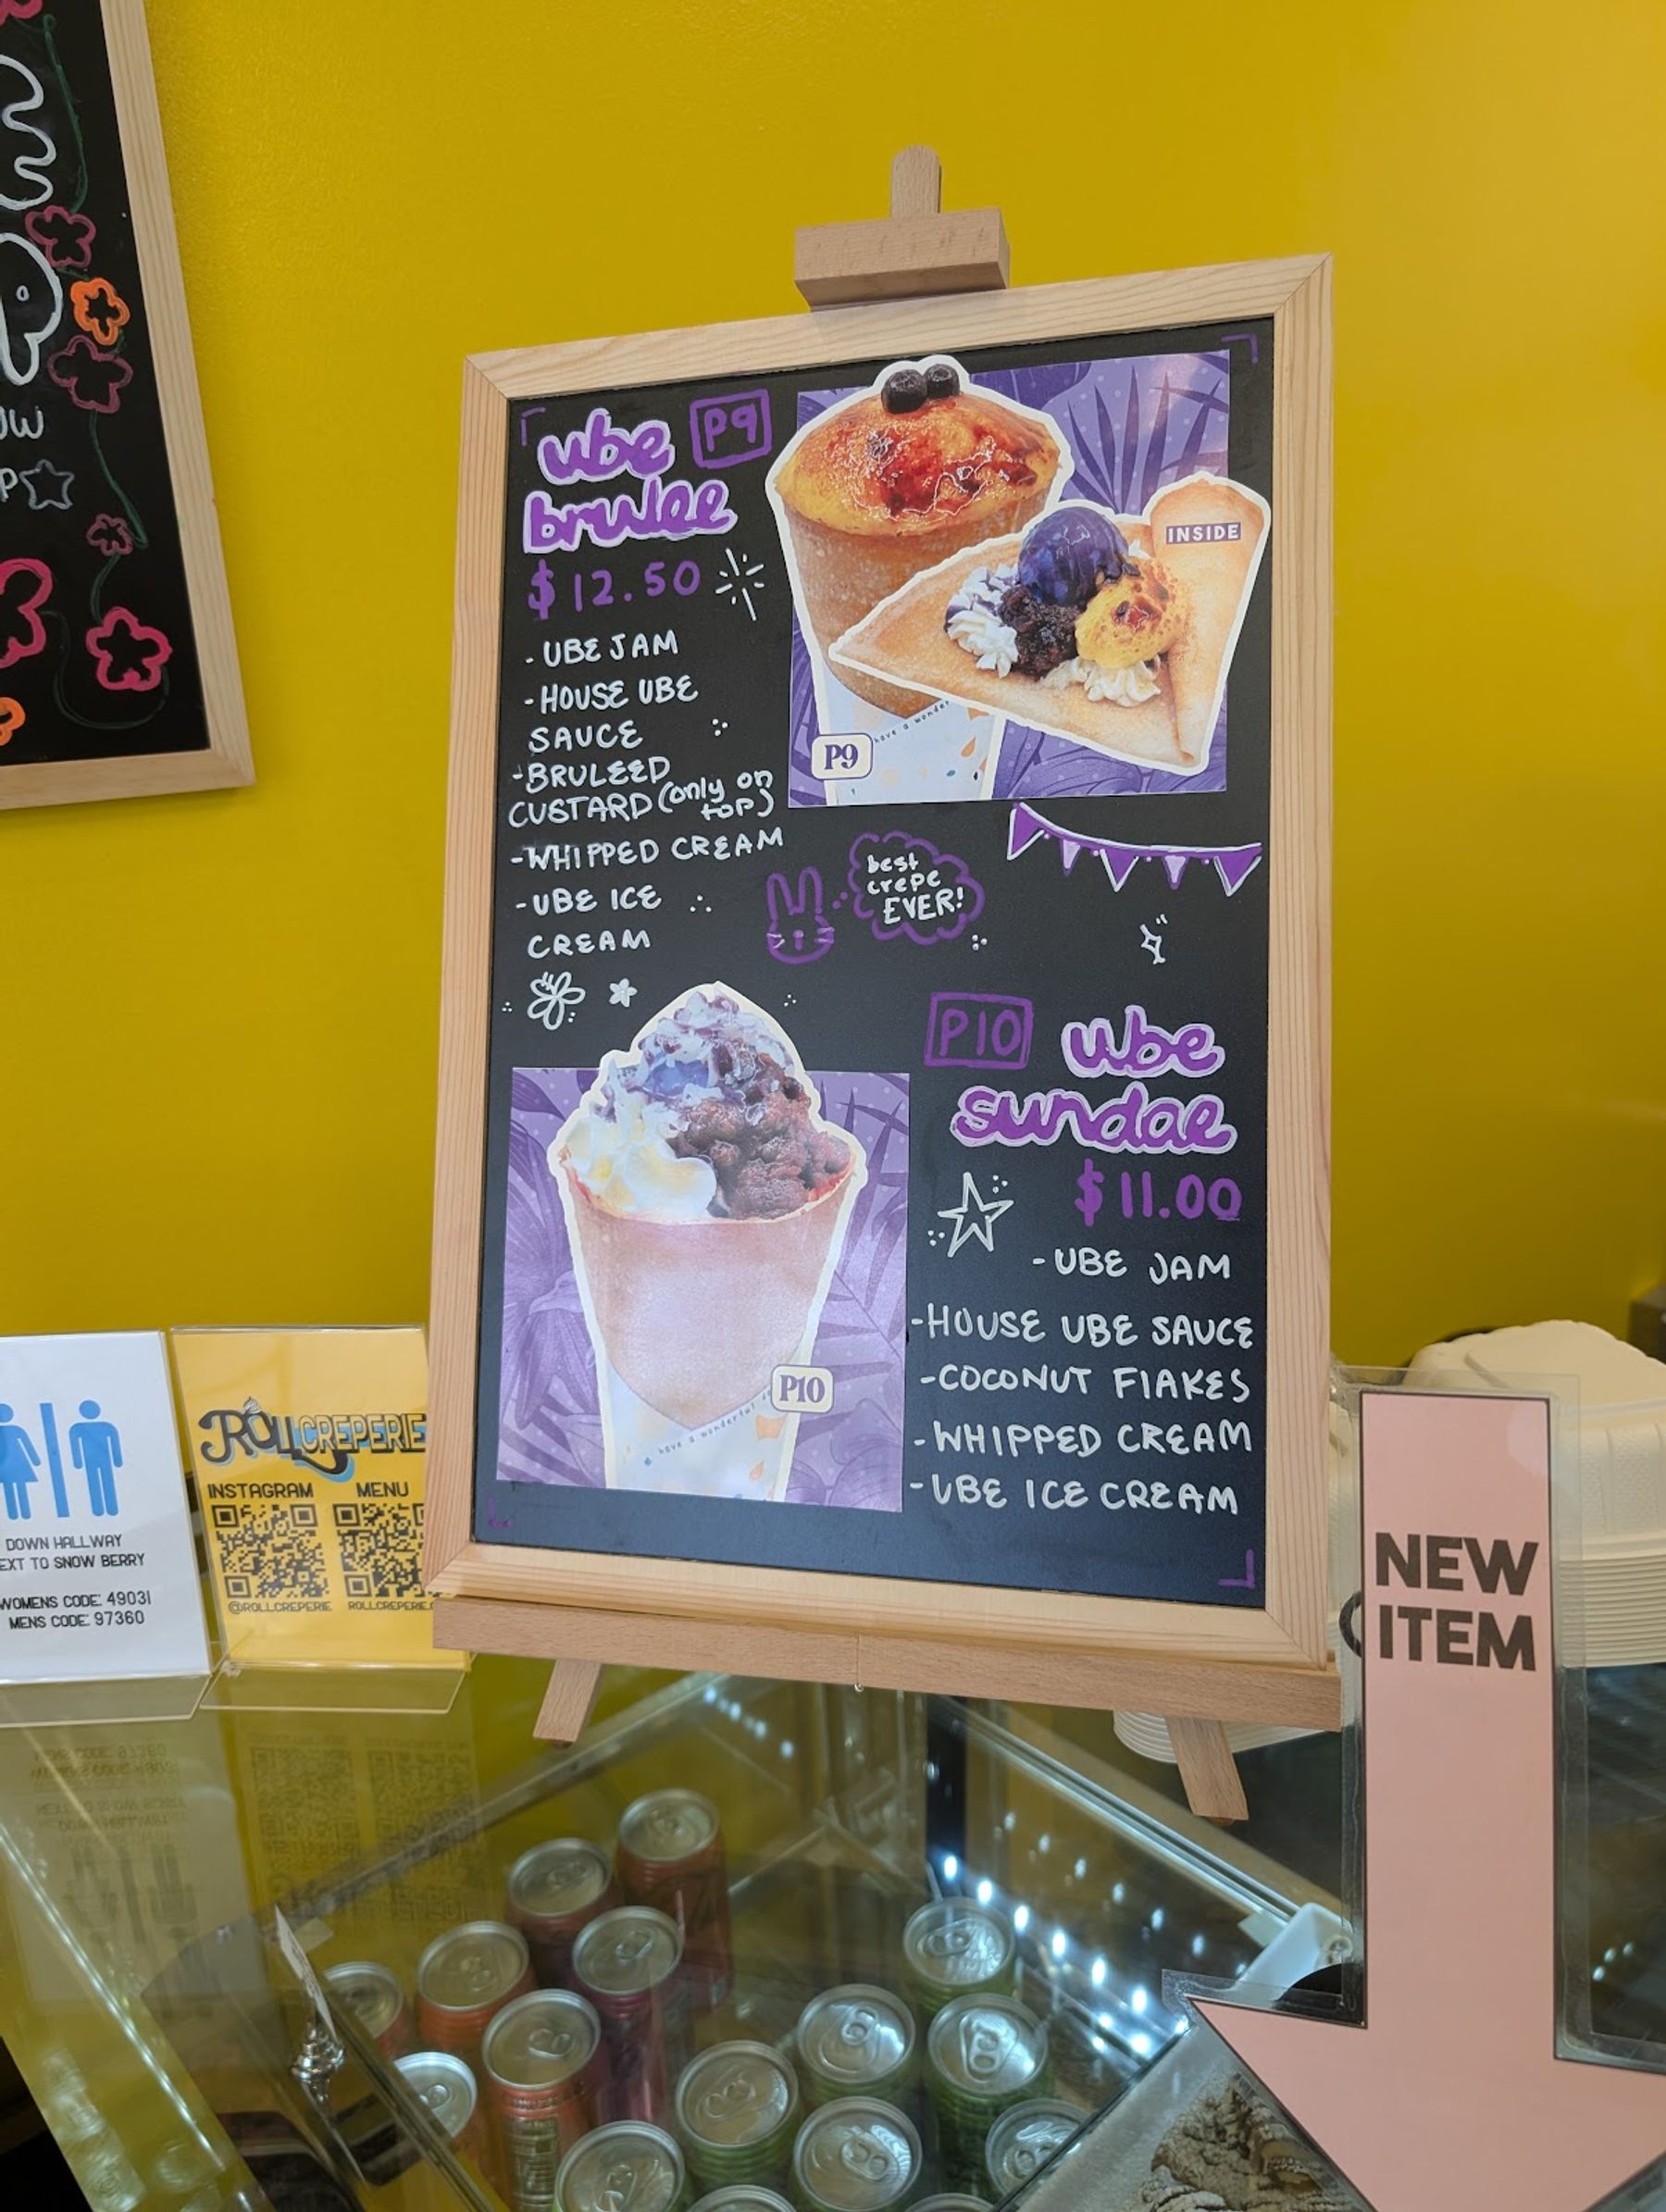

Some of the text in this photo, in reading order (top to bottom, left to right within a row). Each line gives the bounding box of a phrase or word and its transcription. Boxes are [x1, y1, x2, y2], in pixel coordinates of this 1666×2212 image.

[537, 407, 675, 485] ube
[523, 475, 739, 553] brulee
[1168, 524, 1239, 543] INSIDE
[609, 629, 678, 661] JAM
[639, 675, 699, 704] UBE
[528, 719, 643, 753] SAUCE
[824, 743, 859, 770] P9
[509, 792, 653, 827] CUSTARD
[737, 770, 774, 789] on
[671, 826, 784, 861] CREAM
[866, 851, 918, 874] best
[611, 885, 663, 911] ICE
[866, 870, 941, 895] crepe
[883, 887, 964, 925] EVER!
[528, 928, 651, 959] CREAM
[939, 1008, 1021, 1057] P10
[1061, 1004, 1225, 1078] ube
[950, 1081, 1238, 1155] sundae
[1149, 1252, 1231, 1285] JAM
[1061, 1313, 1138, 1348] UBE
[1151, 1315, 1253, 1348] SAUCE
[778, 1374, 826, 1403] P10
[1117, 1419, 1252, 1456] CREAM
[208, 1482, 409, 1498] INSTAGRAM MENU
[1026, 1480, 1088, 1510] ICE
[1100, 1480, 1237, 1515] CREAM
[6, 1534, 122, 1551] DOWN HALLWAY
[31, 1557, 49, 1570] TO
[54, 1555, 95, 1569] SNOW
[101, 1553, 144, 1567] BERRY
[1375, 1532, 1539, 1596] NEW
[107, 1590, 151, 1606] 49031
[229, 1600, 332, 1614] @ROLLCREPERIE
[9, 1617, 47, 1629] MENS
[94, 1610, 145, 1625] 97360
[1379, 1604, 1536, 1671] ITEM
